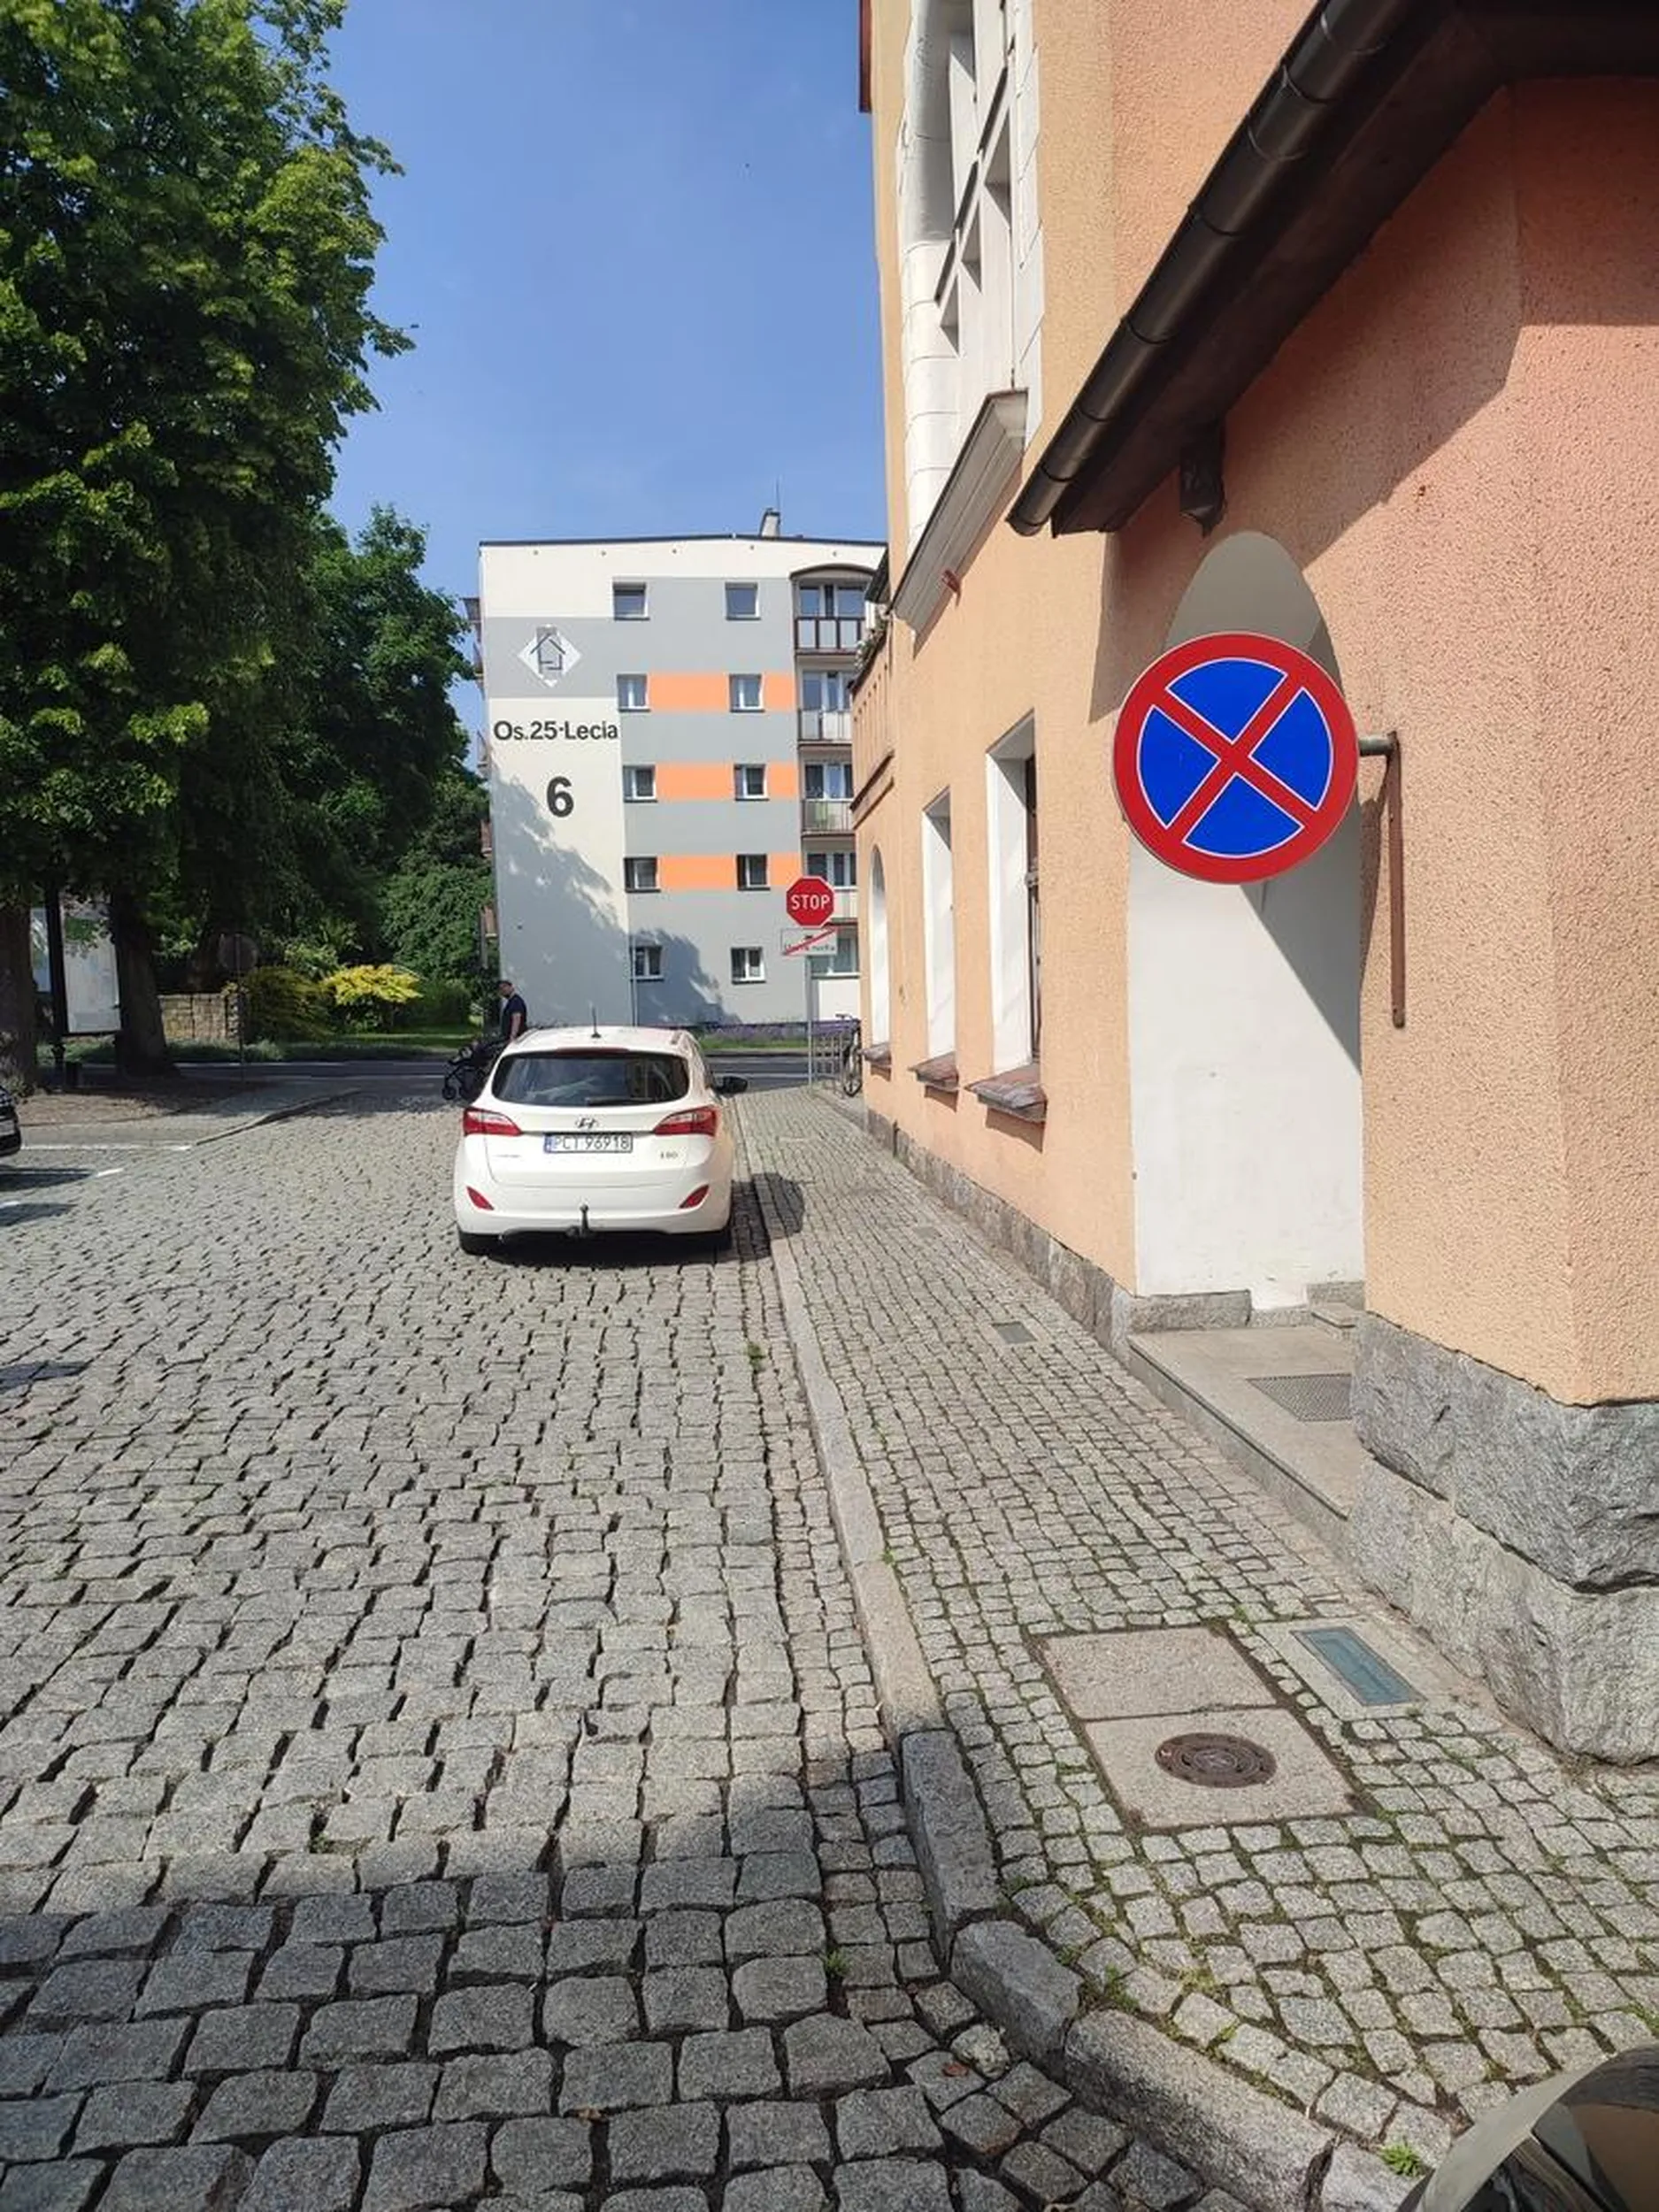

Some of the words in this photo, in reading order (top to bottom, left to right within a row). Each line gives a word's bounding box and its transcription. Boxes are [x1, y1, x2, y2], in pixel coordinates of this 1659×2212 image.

[546, 776, 574, 818] 6
[790, 894, 831, 910] STOP
[585, 1135, 629, 1149] 96918
